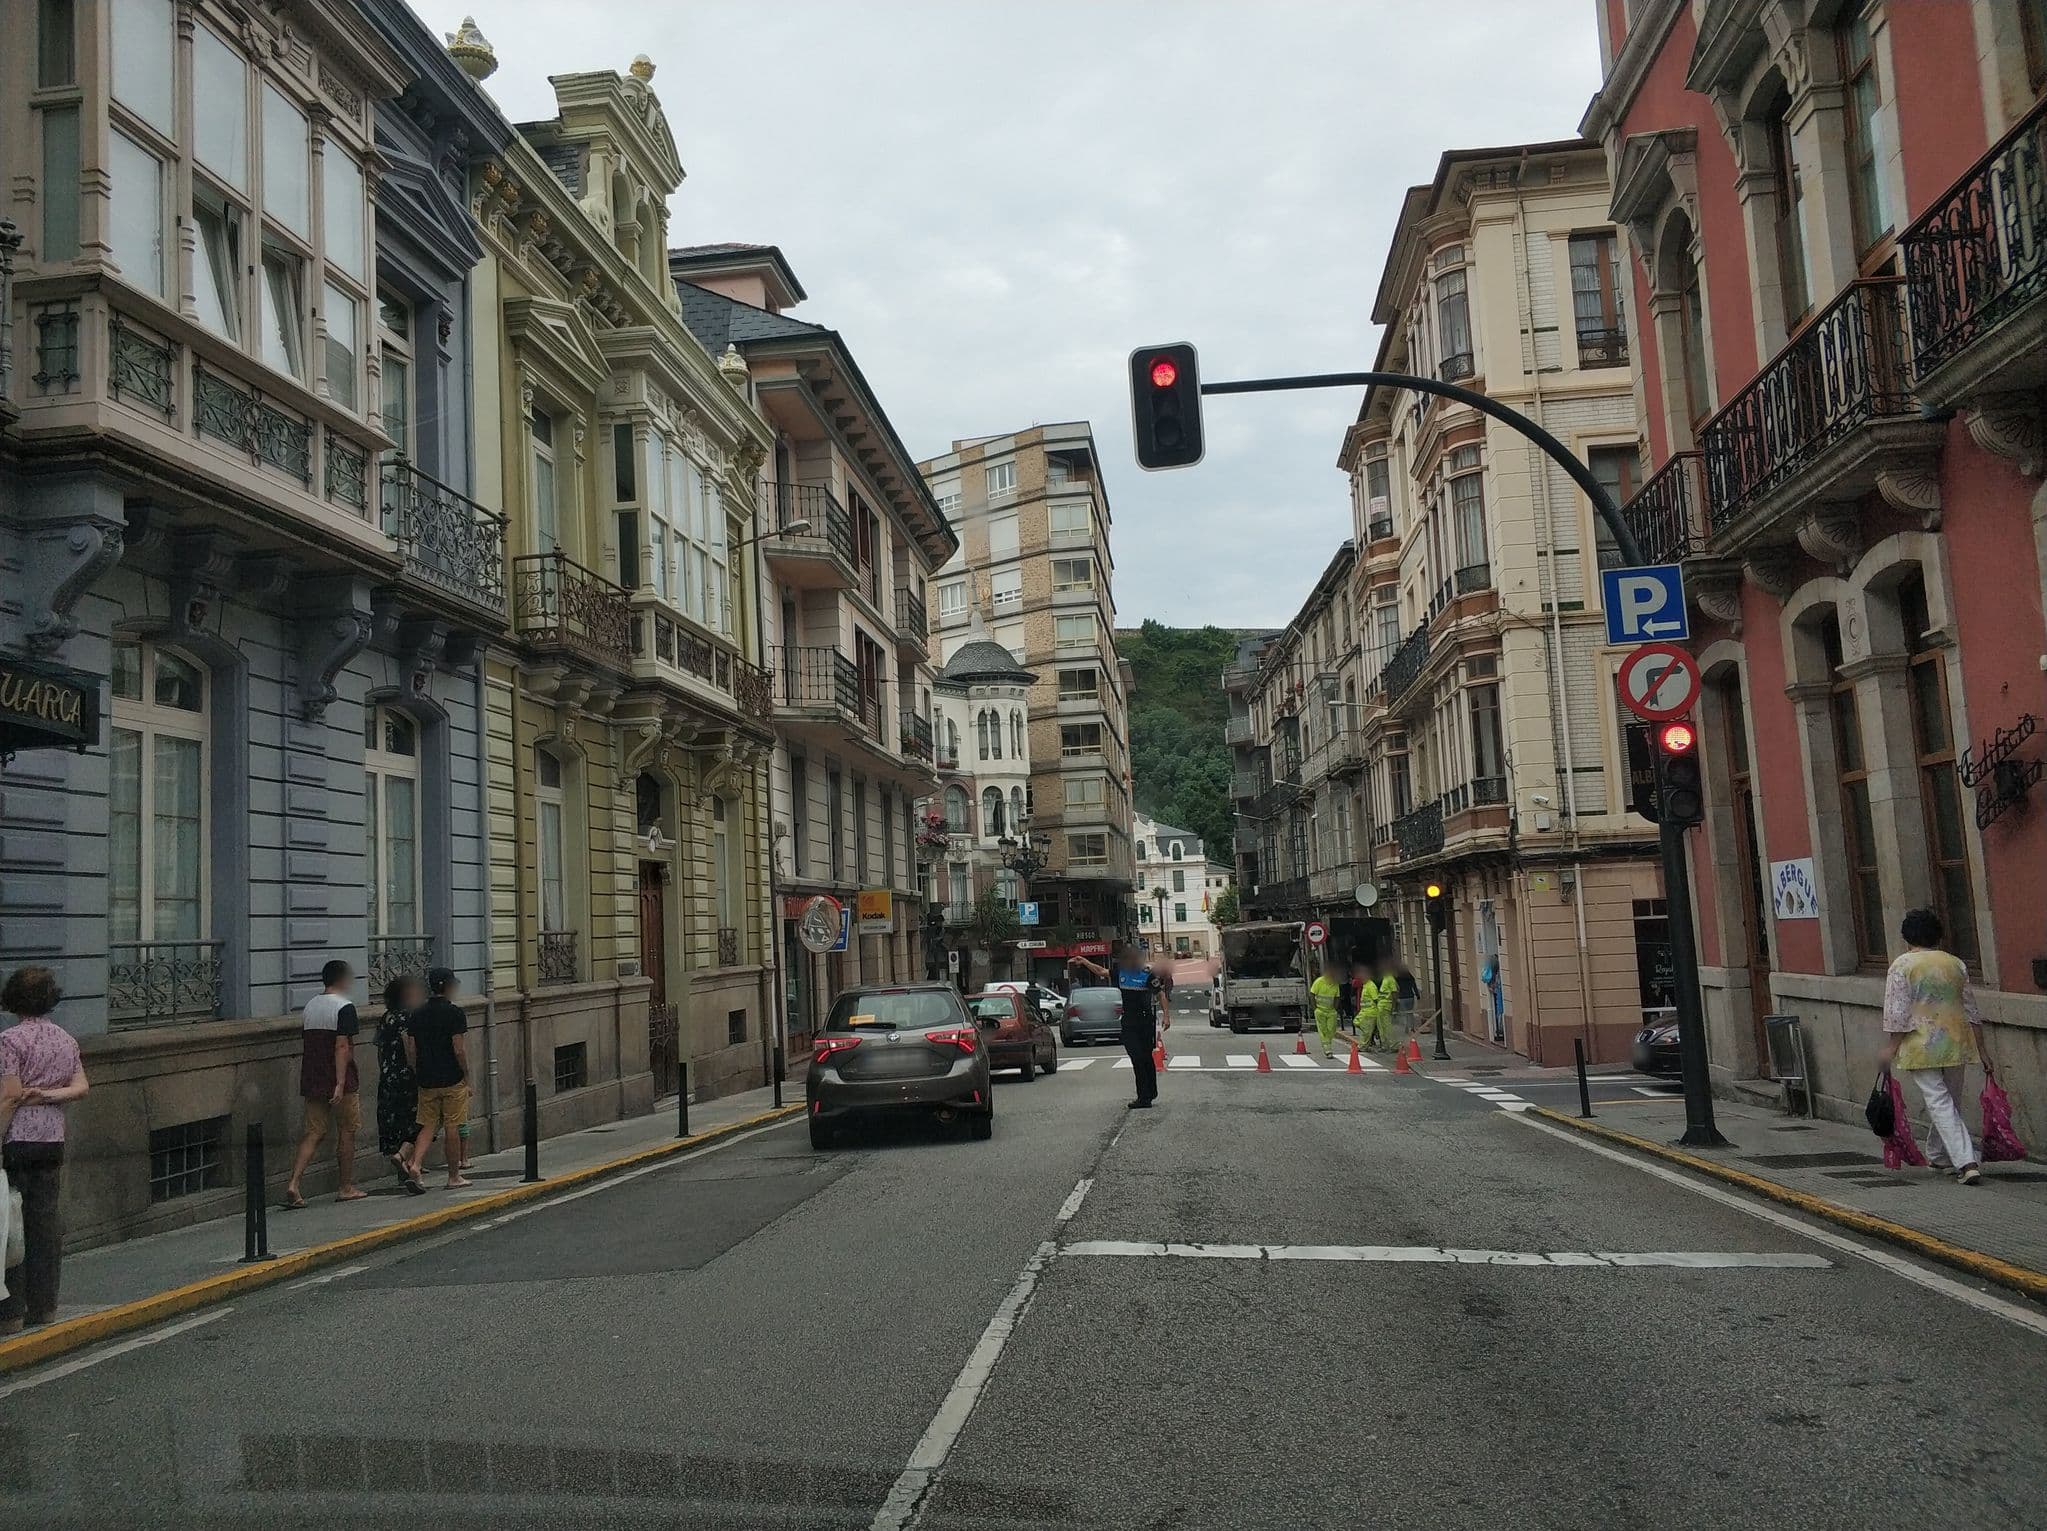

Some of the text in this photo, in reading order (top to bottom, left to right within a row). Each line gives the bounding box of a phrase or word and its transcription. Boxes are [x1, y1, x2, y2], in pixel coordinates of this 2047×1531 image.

[1618, 575, 1668, 635] P
[0, 672, 81, 727] UARCA
[1775, 863, 1818, 915] ALBERGUE
[862, 911, 887, 920] Kodak
[1080, 944, 1105, 953] MAPFRE
